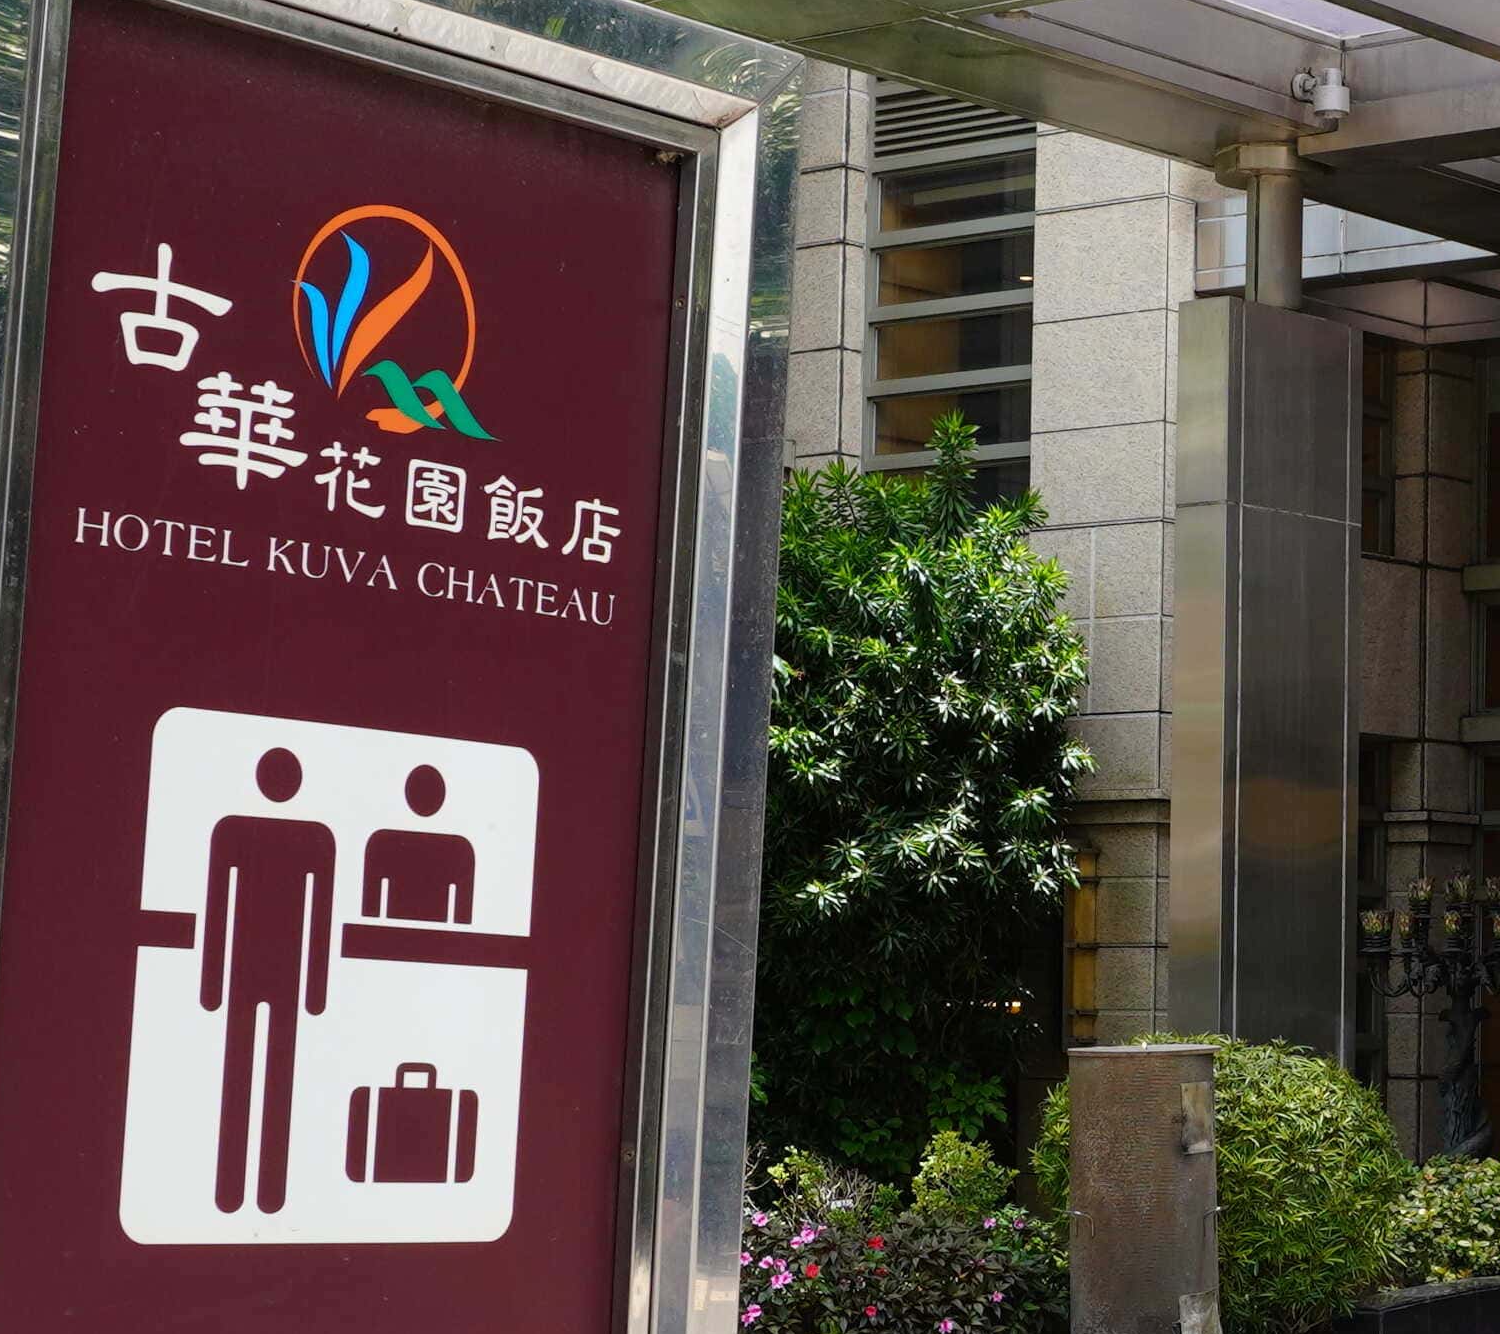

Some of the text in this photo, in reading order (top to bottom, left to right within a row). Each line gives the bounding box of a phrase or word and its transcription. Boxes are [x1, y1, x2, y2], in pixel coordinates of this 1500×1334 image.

[75, 507, 616, 625] HOTEL KUVA CHATEAU
